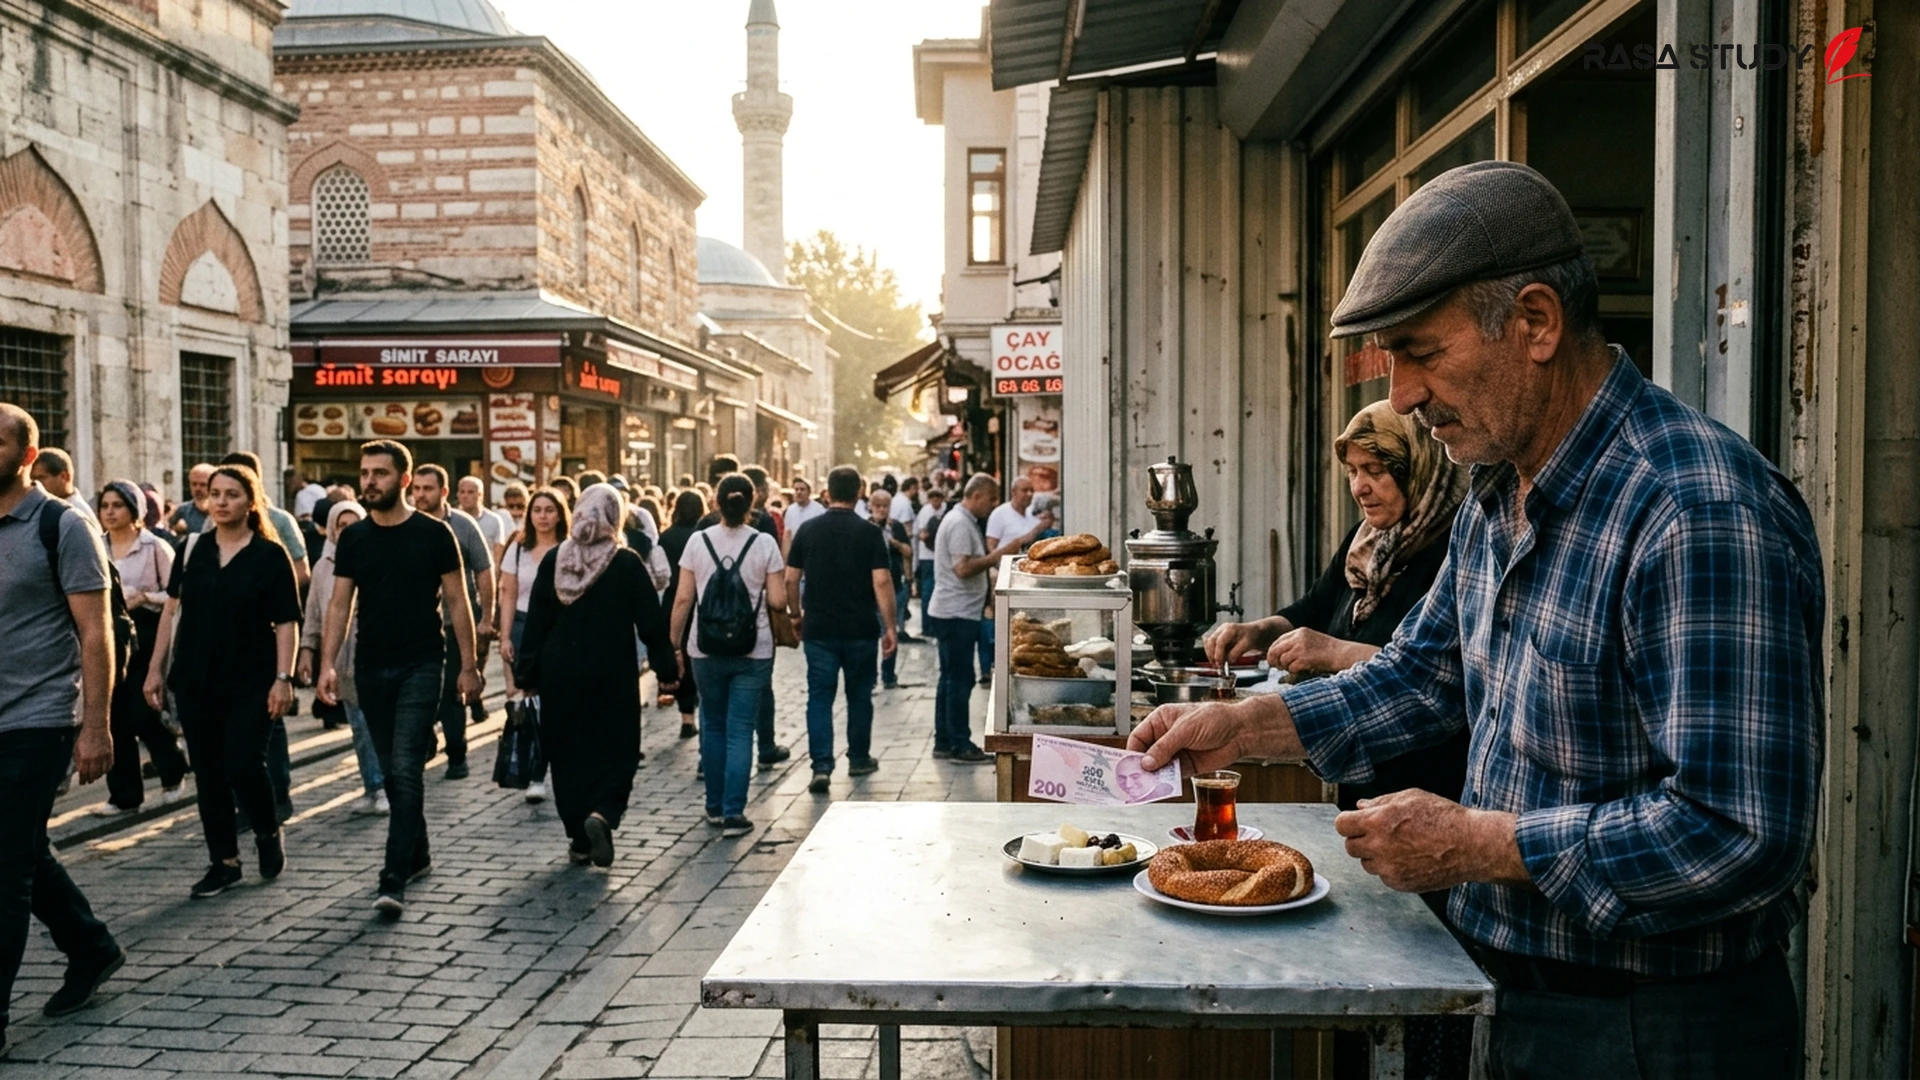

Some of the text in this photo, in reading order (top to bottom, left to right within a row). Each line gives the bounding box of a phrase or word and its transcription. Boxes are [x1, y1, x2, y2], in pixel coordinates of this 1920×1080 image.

[1006, 331, 1051, 351] ÇAY
[435, 349, 499, 363] SARAYI
[315, 363, 375, 386] simit
[1034, 779, 1067, 798] 200
